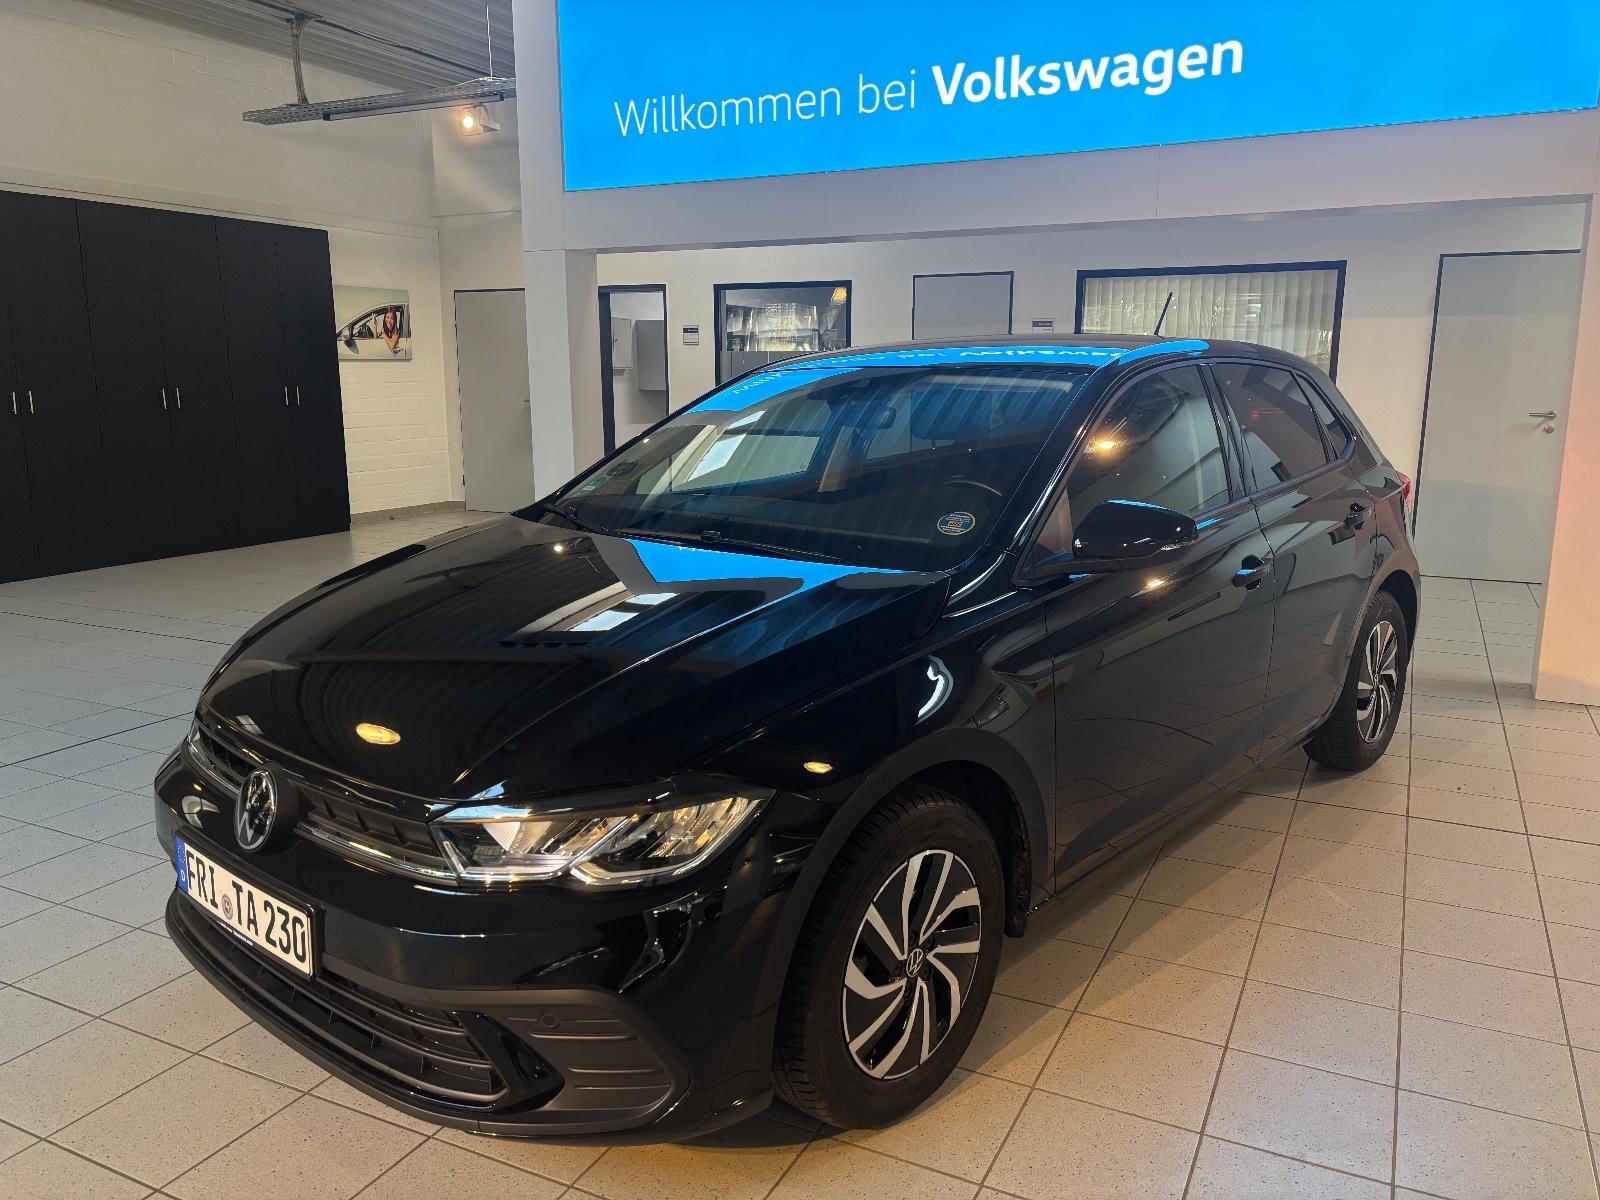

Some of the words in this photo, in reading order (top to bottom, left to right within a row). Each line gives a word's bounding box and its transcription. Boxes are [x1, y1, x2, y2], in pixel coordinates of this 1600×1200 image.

[614, 87, 842, 137] Willkommen
[858, 70, 916, 114] bei
[931, 39, 1243, 105] Volkswagen
[186, 849, 219, 909] FRI
[232, 879, 259, 937] TA
[263, 899, 307, 964] 230
